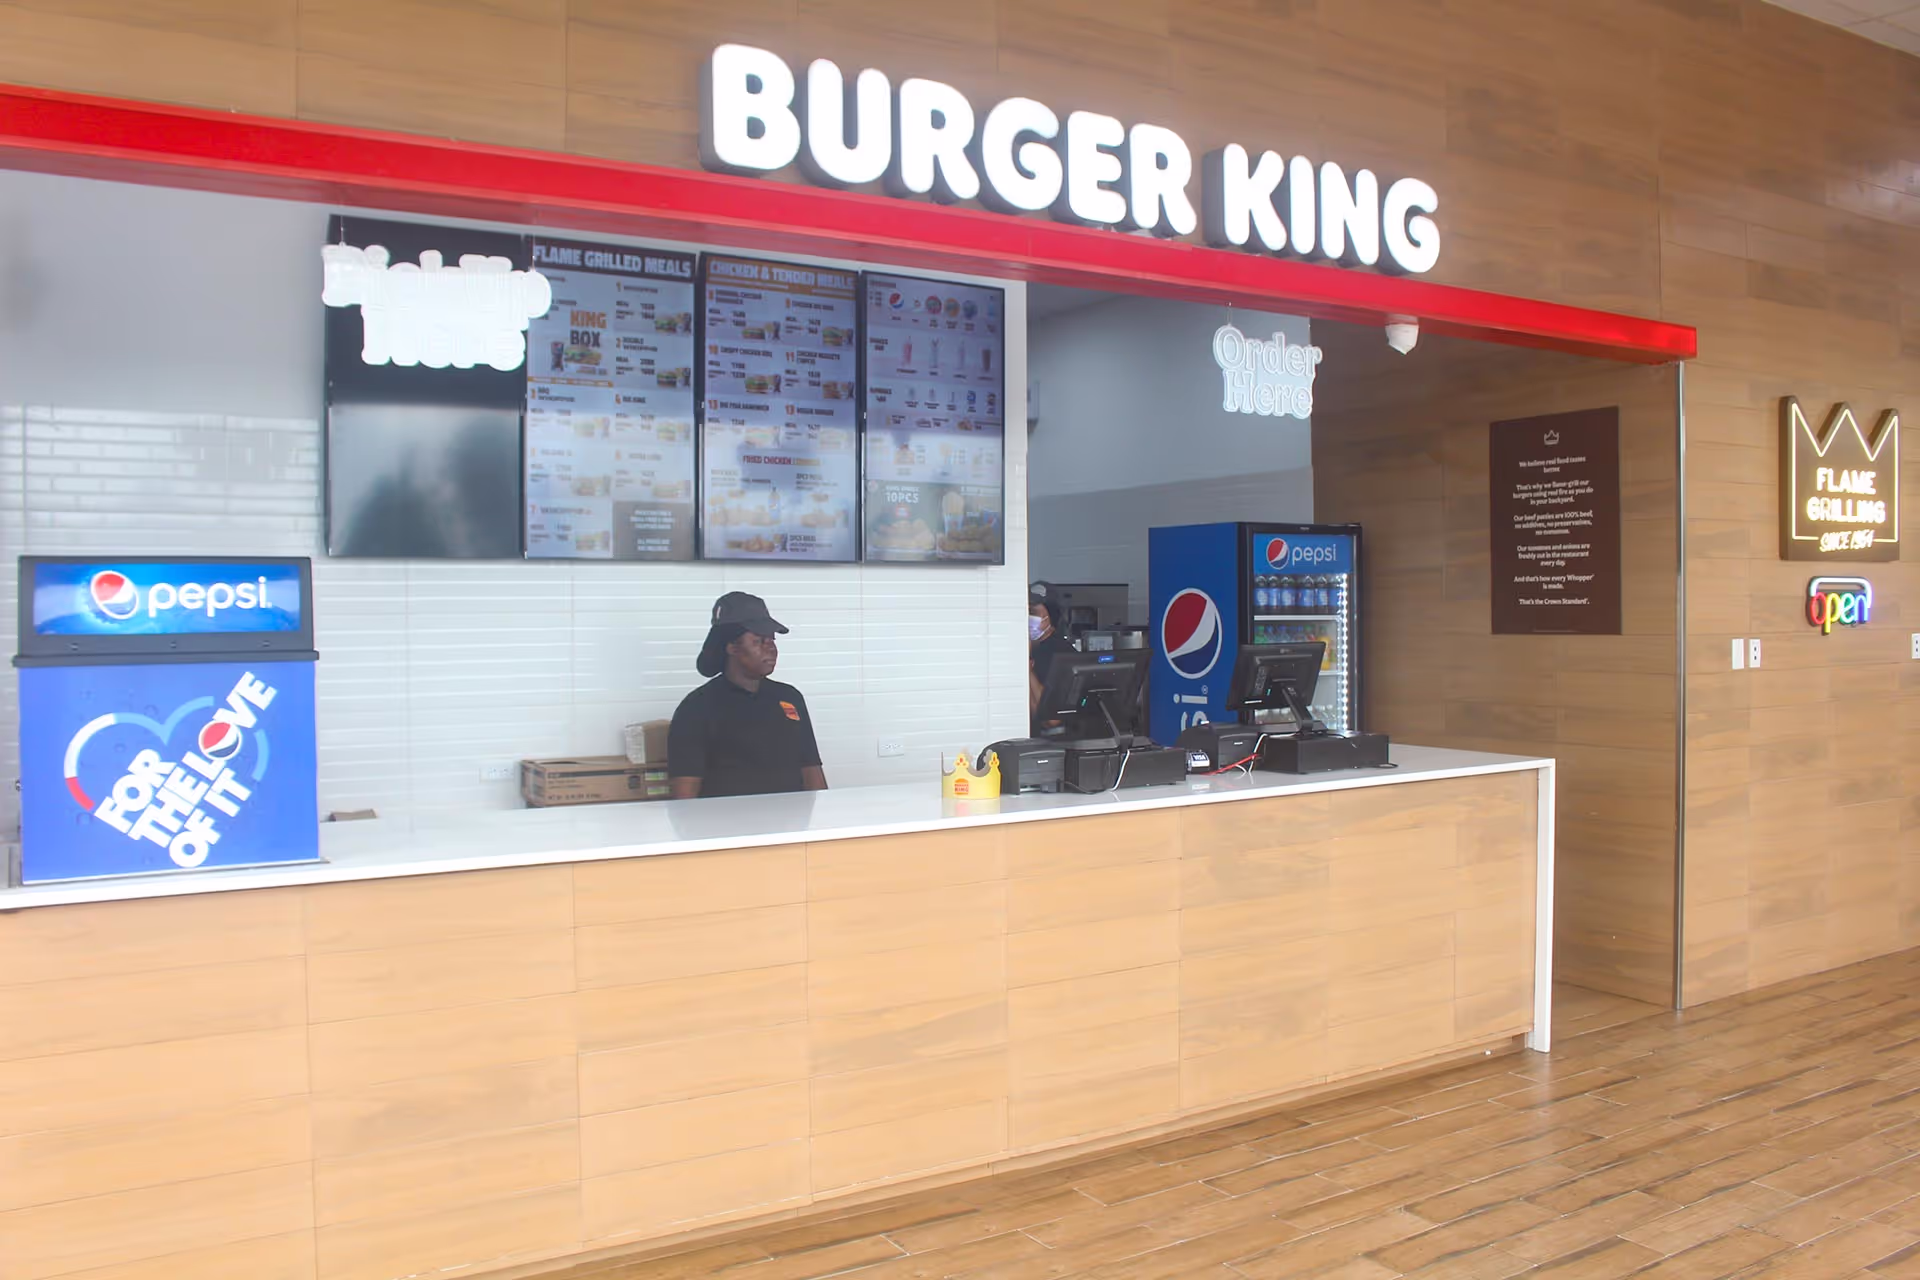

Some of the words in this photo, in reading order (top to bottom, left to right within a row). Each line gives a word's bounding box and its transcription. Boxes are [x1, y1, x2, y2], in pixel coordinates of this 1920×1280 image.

[711, 43, 1197, 235] BURGER
[1223, 142, 1441, 273] KING
[534, 245, 582, 266] FLAME
[584, 251, 641, 272] GRILLED
[644, 257, 691, 278] MEALS
[710, 260, 758, 280] CHICKEN
[771, 268, 815, 285] TENDER
[570, 310, 606, 329] KING
[570, 330, 601, 348] BOX
[1212, 324, 1322, 377] Order
[1222, 369, 1313, 420] Here
[1546, 458, 1556, 466] real
[1532, 483, 1543, 491] why
[1816, 467, 1877, 495] FLAME
[886, 492, 919, 503] 10PCS
[1513, 492, 1533, 500] burgers
[1575, 488, 1586, 496] you
[1548, 496, 1575, 505] backyard.
[1525, 513, 1537, 521] beef
[1537, 513, 1554, 522] patties
[1806, 496, 1886, 523] GRILLING
[1820, 531, 1851, 552] SINCE
[1292, 544, 1337, 566] pepsi
[1518, 552, 1536, 561] freshly
[1561, 550, 1589, 558] restaurant
[148, 576, 268, 618] pepsi
[1548, 582, 1564, 590] made.
[1811, 591, 1869, 633] open
[128, 765, 210, 849] THE
[182, 671, 278, 782] LOVE
[94, 748, 176, 834] FOR
[169, 808, 221, 868] OF
[203, 767, 252, 818] IT
